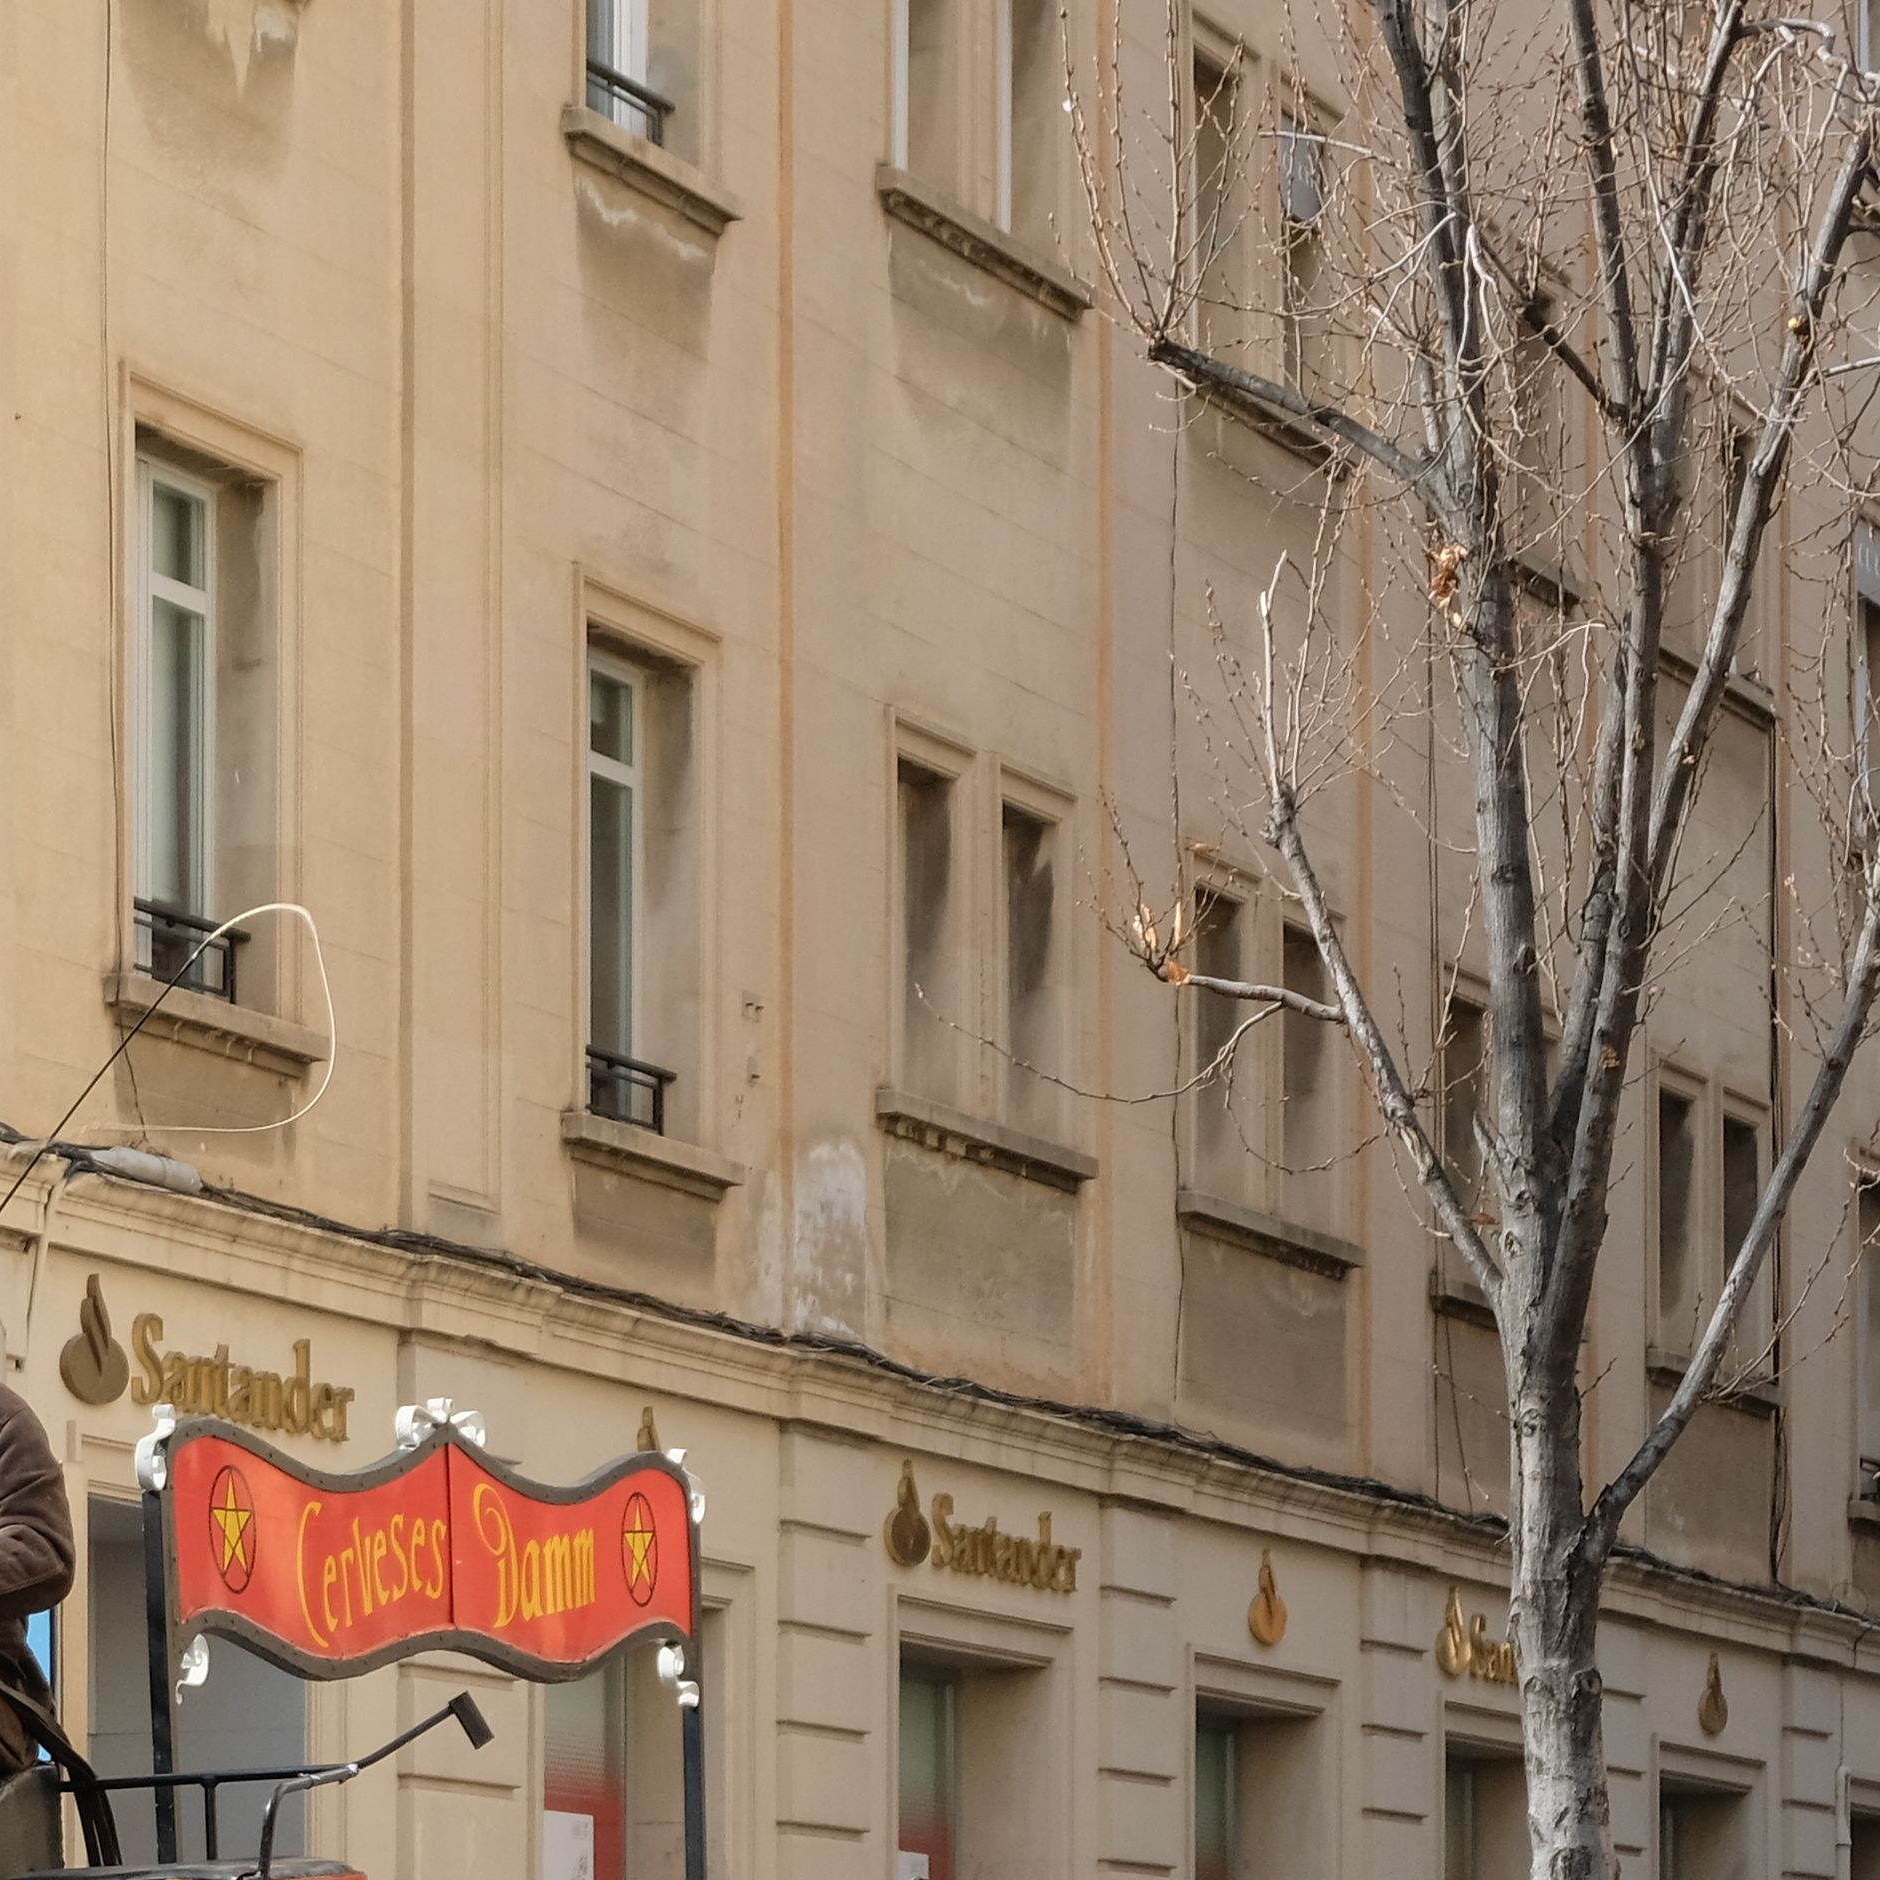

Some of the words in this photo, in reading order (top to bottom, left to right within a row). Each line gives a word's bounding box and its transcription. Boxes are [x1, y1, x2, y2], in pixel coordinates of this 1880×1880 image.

[131, 1313, 355, 1441] Santander
[297, 1501, 447, 1647] Cerveses
[473, 1483, 596, 1628] Damm
[931, 1493, 1082, 1592] Santander
